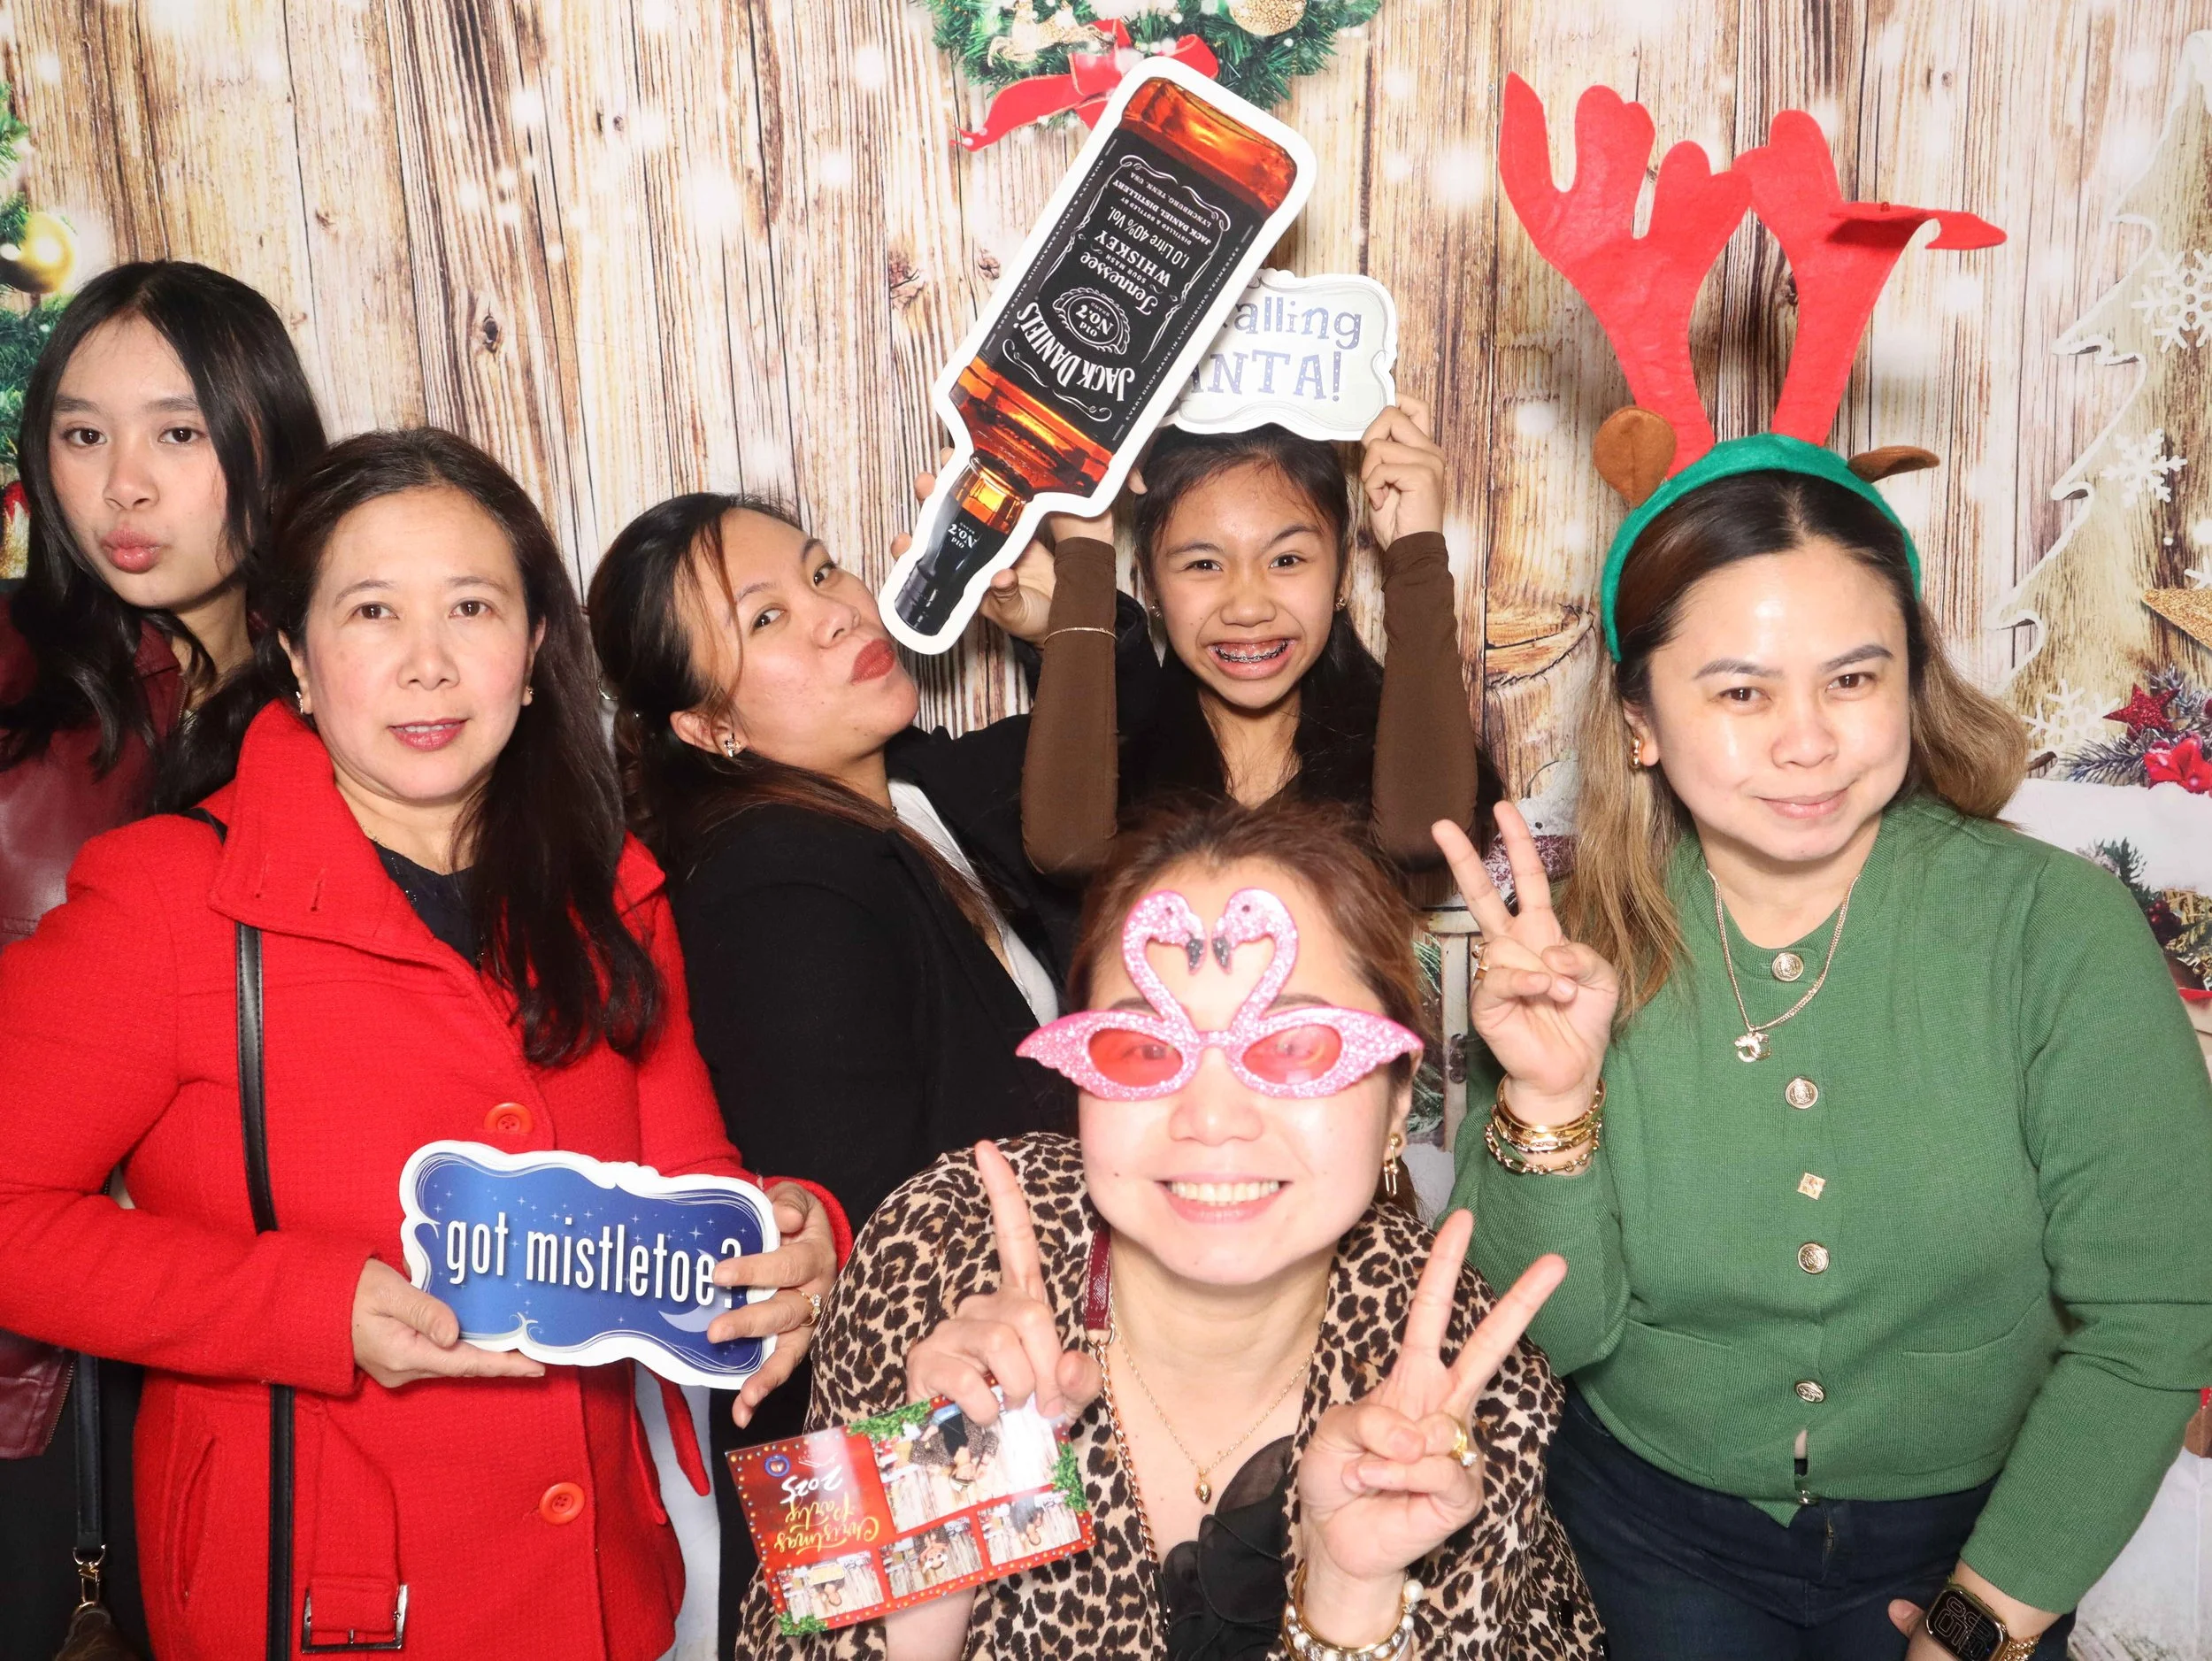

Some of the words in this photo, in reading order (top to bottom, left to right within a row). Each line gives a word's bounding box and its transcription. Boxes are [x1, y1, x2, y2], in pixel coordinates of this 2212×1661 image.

[1078, 159, 1104, 198] QUALITY
[1129, 172, 1144, 184] USA
[1111, 179, 1159, 212] DISTILLERY
[1106, 205, 1127, 228] Vol.
[1129, 202, 1156, 221] BOTTLED
[1159, 208, 1189, 232] DANIEL
[1026, 207, 1074, 281] CRAFTSMANSHIP
[1124, 218, 1150, 242] 40%
[1161, 223, 1191, 246] DISTILLED
[1188, 227, 1212, 245] JACK
[1094, 228, 1171, 287] WHISKEY
[1148, 234, 1175, 258] Litre
[1104, 253, 1125, 270] MASH
[1125, 267, 1147, 283] SOUR
[1079, 251, 1159, 317] Tennessee
[1090, 301, 1110, 317] BRAND
[1225, 296, 1362, 350] alling
[1078, 320, 1099, 337] Old
[1125, 396, 1143, 421] EVERY
[1141, 373, 1157, 396] DROP
[1156, 350, 1171, 373] MADE
[1177, 293, 1209, 340] LYNCHBURG
[1207, 246, 1240, 292] TENNESSEE
[1014, 302, 1081, 388] DANIEL'S
[1076, 359, 1136, 402] JACK
[950, 536, 964, 549] Old
[446, 1211, 508, 1284] got
[526, 1217, 741, 1309] mistletoe?
[780, 1465, 843, 1504] 2025
[785, 1492, 855, 1530] Party
[774, 1516, 880, 1555] Christmas
